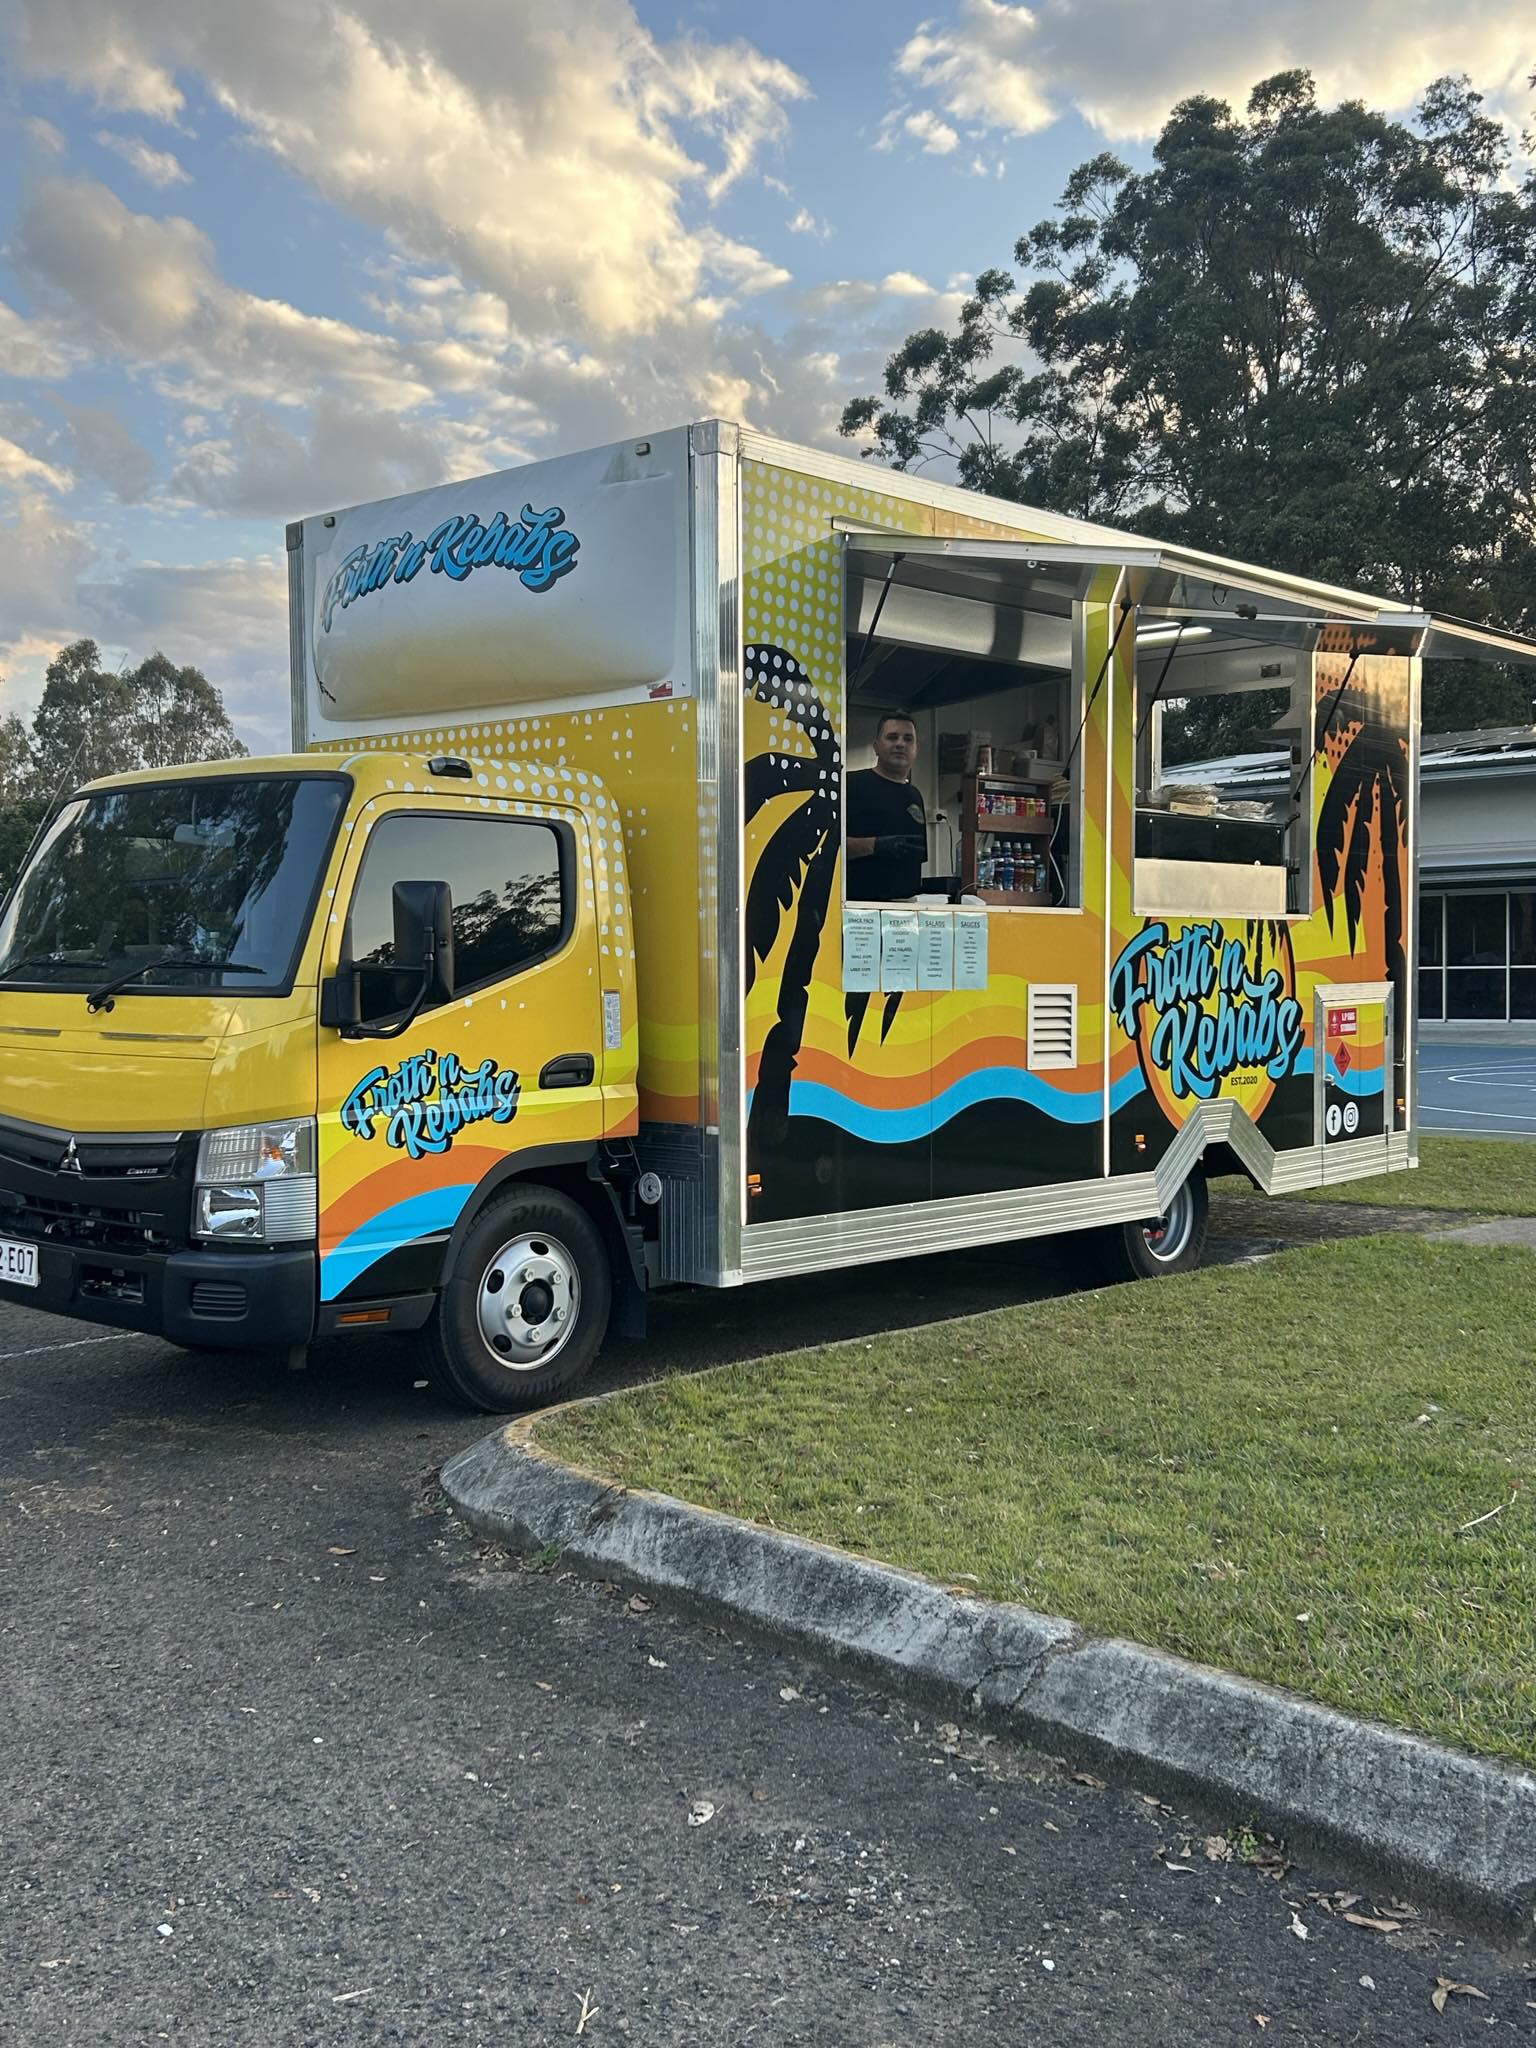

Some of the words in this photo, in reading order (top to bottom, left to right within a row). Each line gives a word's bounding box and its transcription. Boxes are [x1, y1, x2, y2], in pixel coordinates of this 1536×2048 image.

[425, 503, 581, 593] Kebabs
[925, 920, 945, 928] SALADS
[960, 920, 981, 928] SAUCES
[1150, 968, 1306, 1100] Kebabs
[385, 1058, 522, 1160] Kebabs
